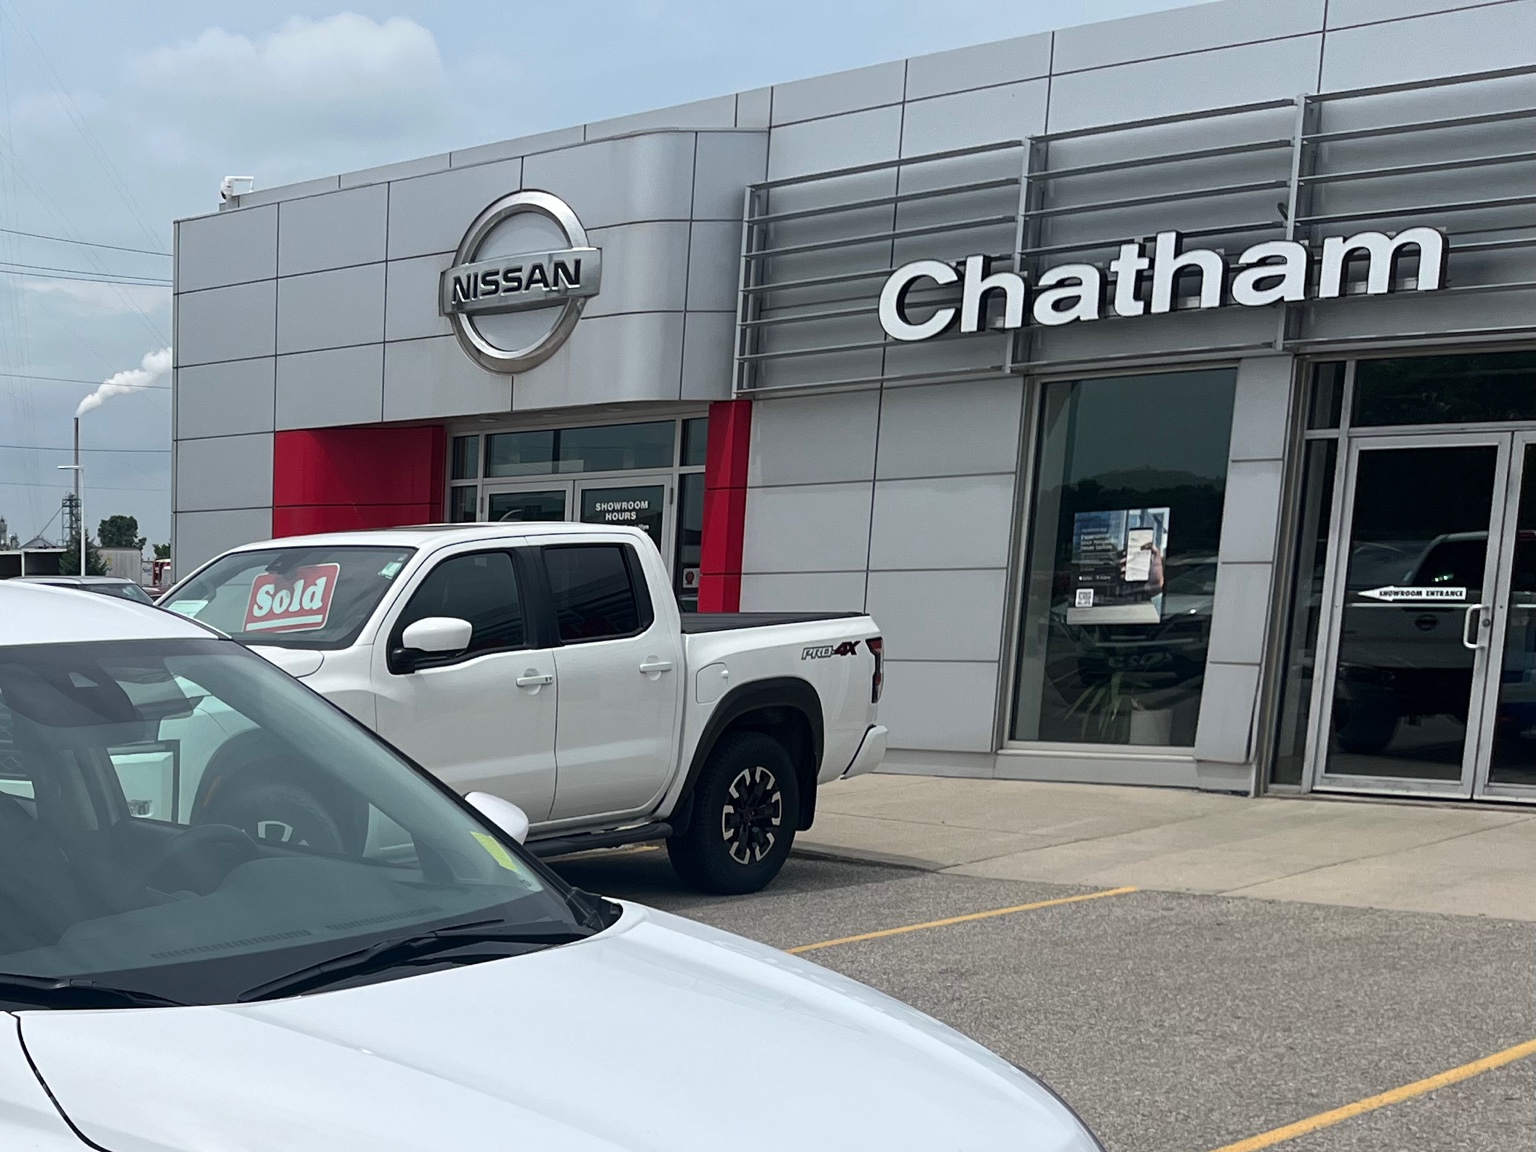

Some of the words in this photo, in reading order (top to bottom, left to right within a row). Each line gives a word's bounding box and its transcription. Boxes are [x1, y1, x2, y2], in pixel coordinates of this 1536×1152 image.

[451, 258, 581, 303] NISSAN
[878, 226, 1446, 341] Chatham
[595, 501, 649, 511] SHOWROOM
[605, 511, 637, 521] HOURS
[252, 576, 327, 617] Sold
[801, 640, 861, 660] PRO-4X
